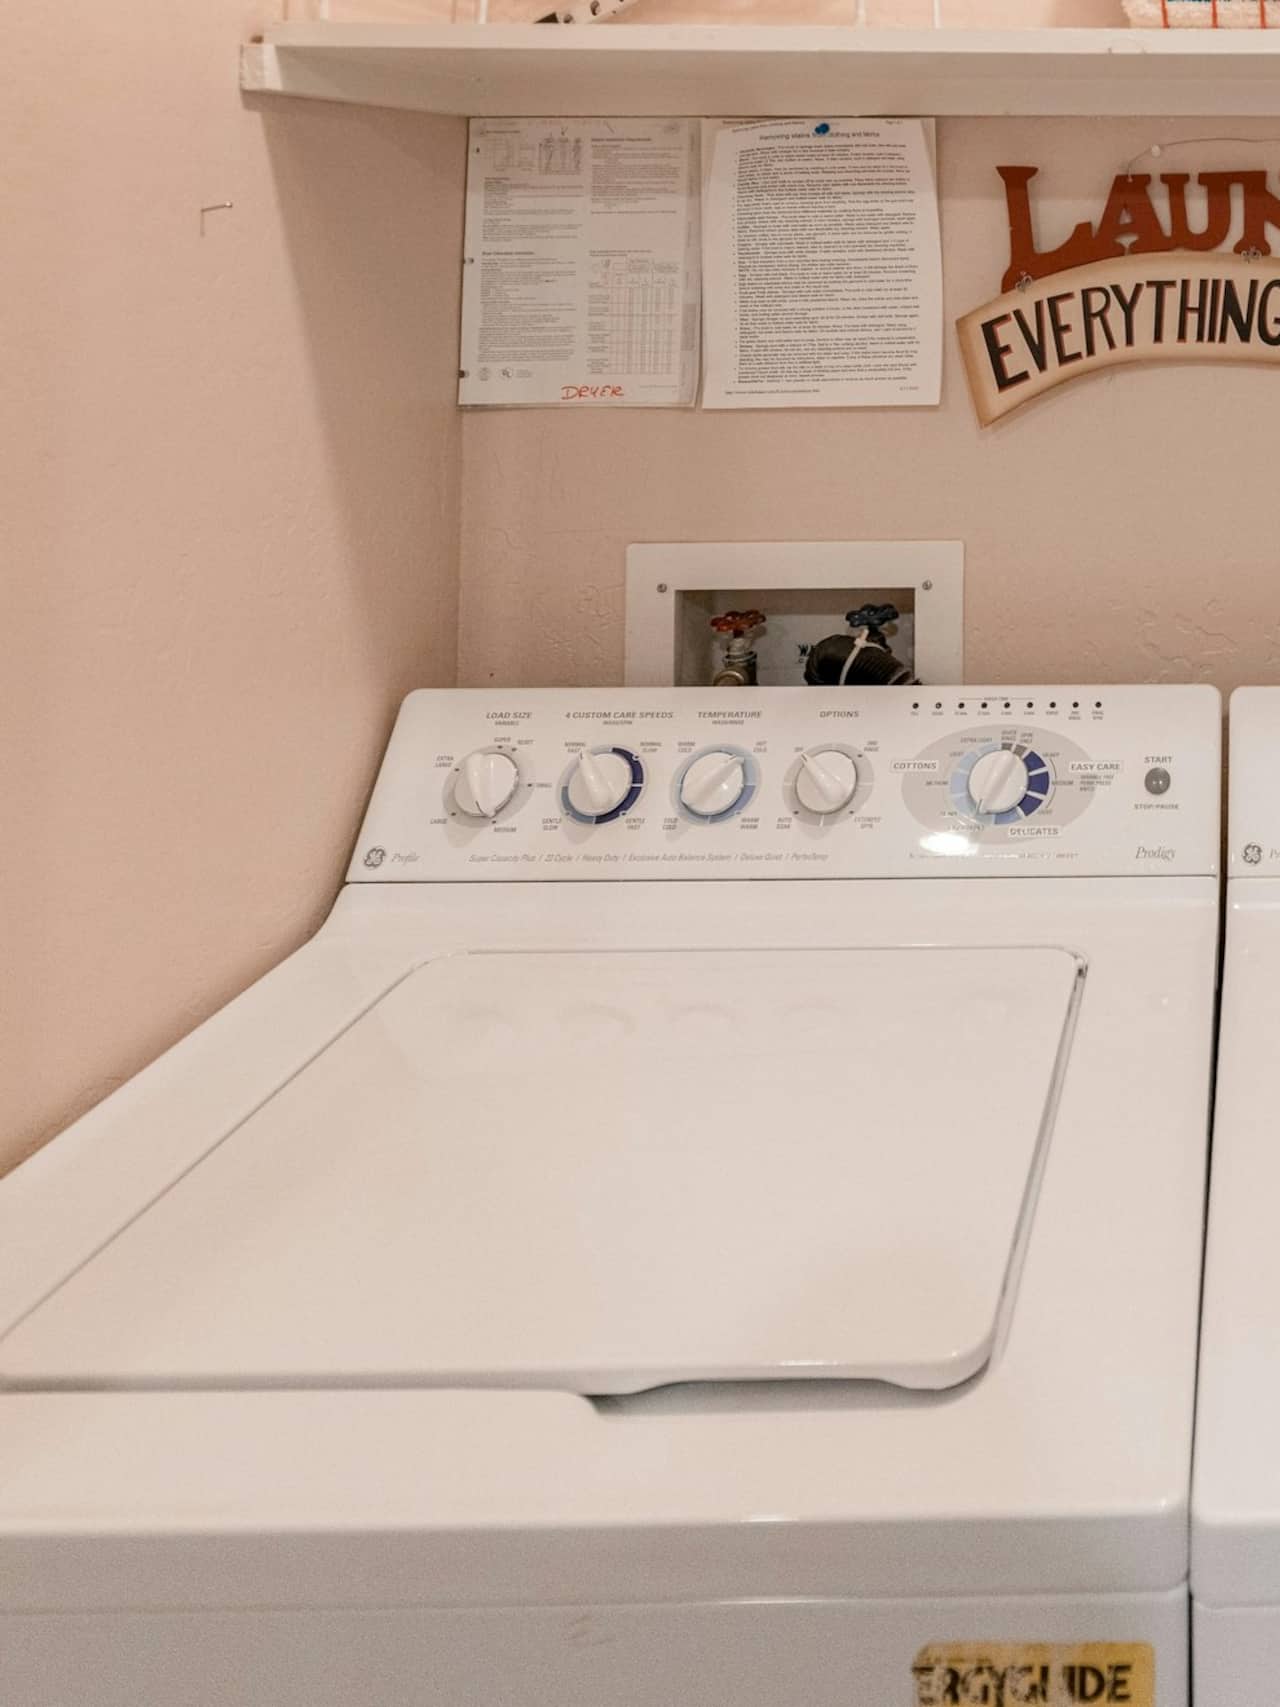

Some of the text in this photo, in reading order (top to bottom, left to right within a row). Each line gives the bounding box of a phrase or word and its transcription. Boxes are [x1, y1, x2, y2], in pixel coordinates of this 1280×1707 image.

[560, 383, 625, 400] DRYER
[486, 711, 533, 720] LOAD SIZE
[573, 711, 612, 720] CUSTOM
[613, 711, 637, 720] CARE
[638, 711, 674, 720] SPEEDS
[698, 711, 763, 720] TEMPERATURE
[819, 710, 860, 719] OPTIONS
[1143, 755, 1173, 764] START
[893, 762, 937, 771] COTTONS
[1071, 763, 1121, 771] EASY CARE
[1010, 827, 1059, 836] DELICATES
[1135, 846, 1176, 861] Prodigy
